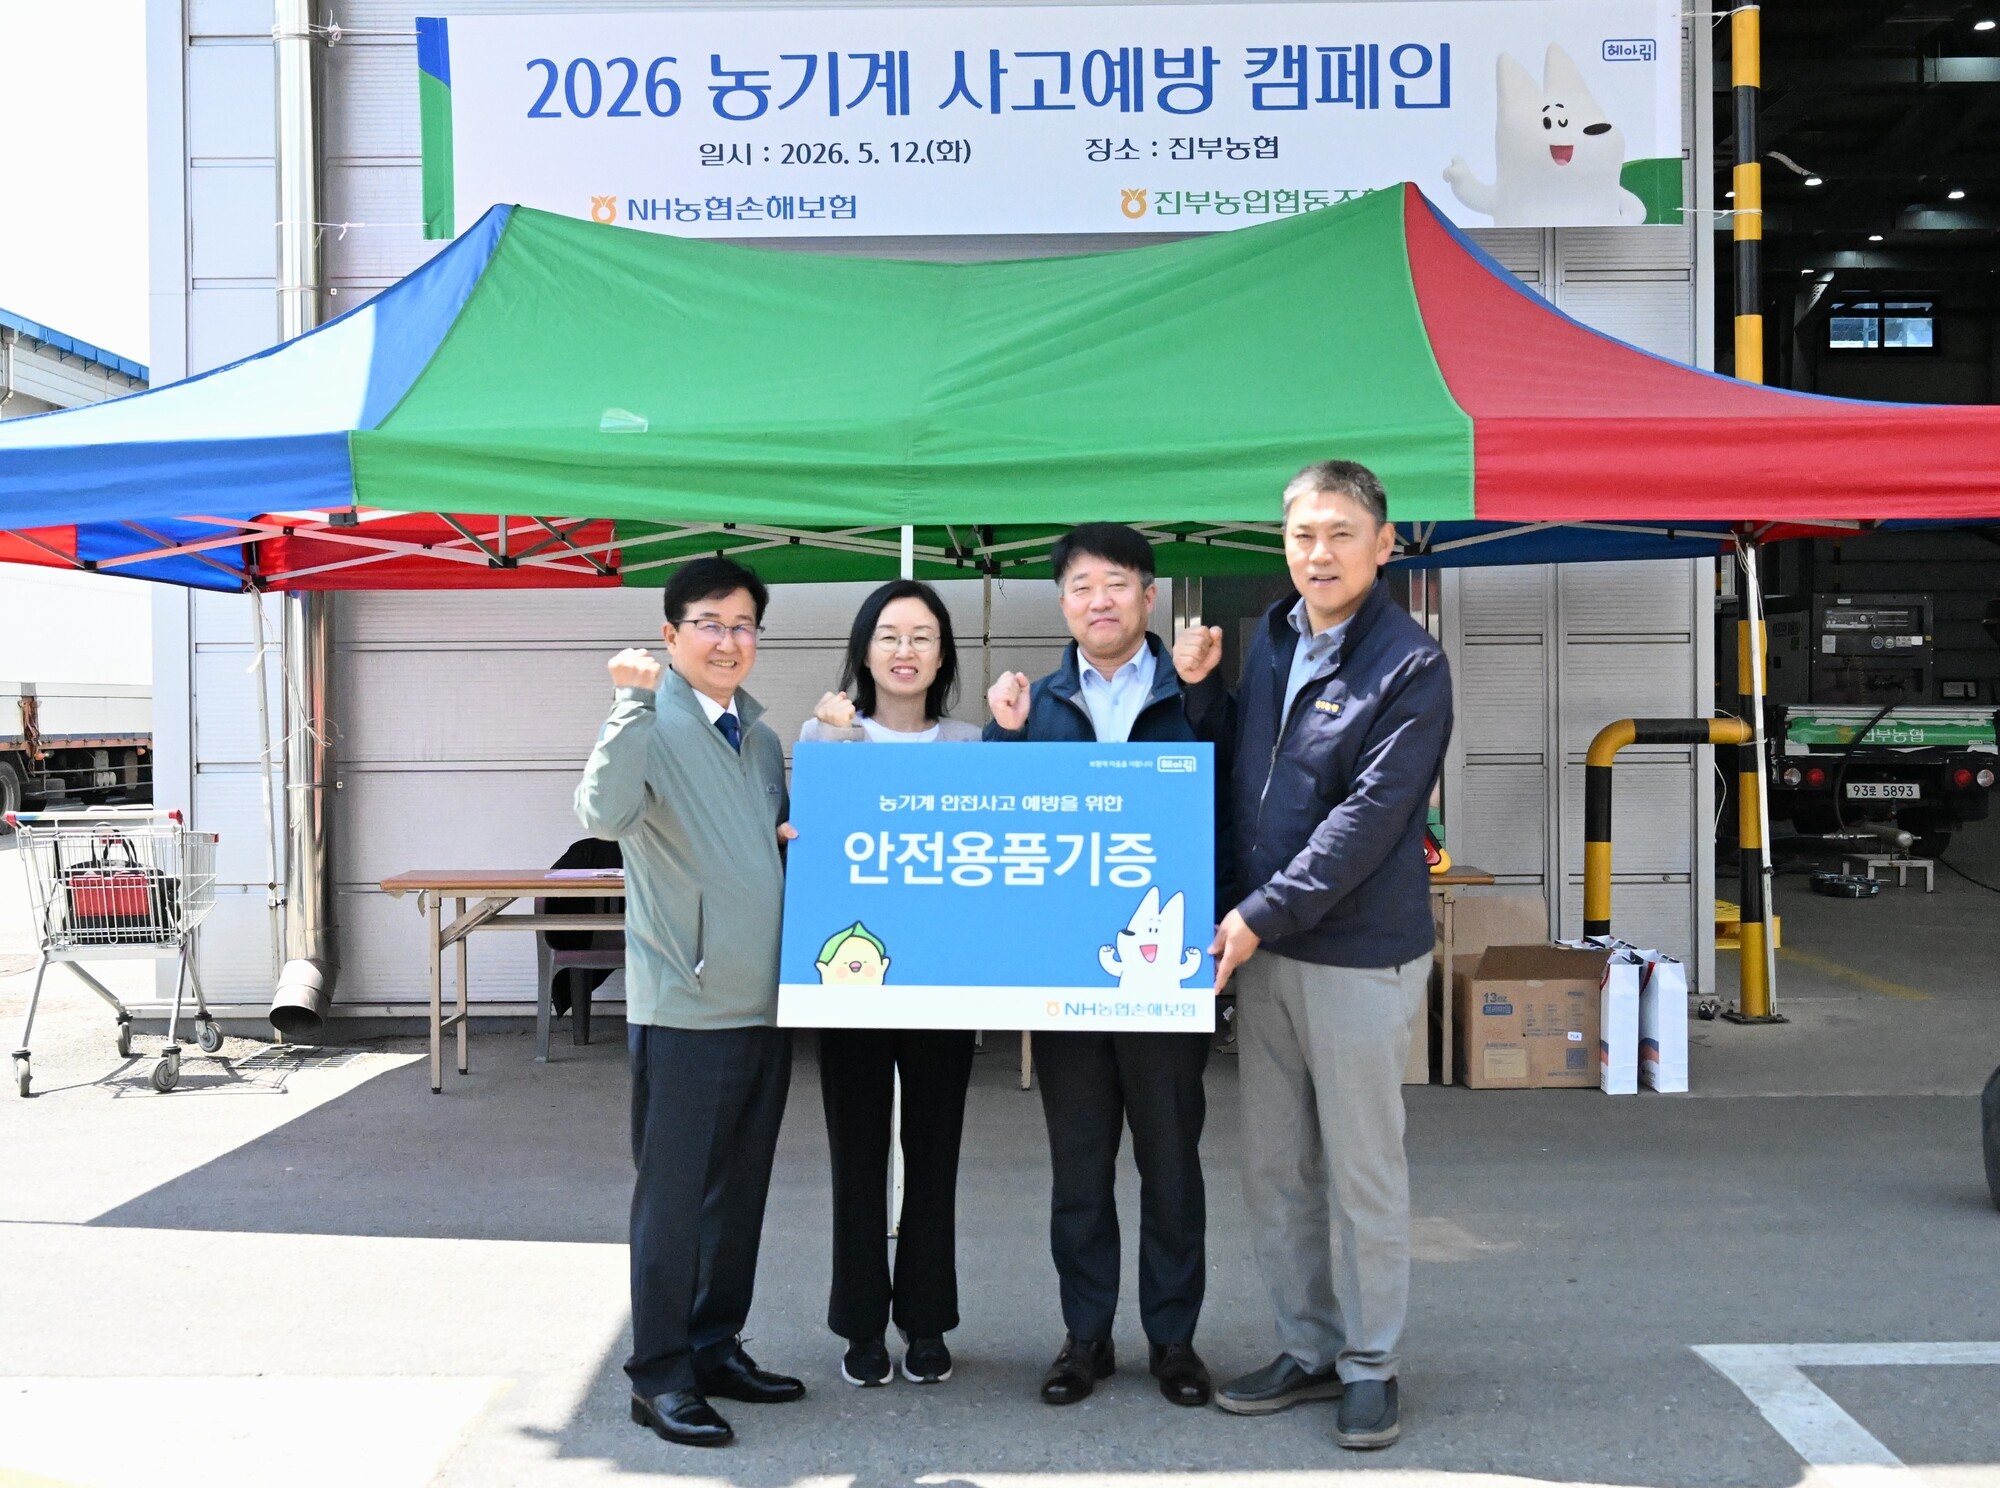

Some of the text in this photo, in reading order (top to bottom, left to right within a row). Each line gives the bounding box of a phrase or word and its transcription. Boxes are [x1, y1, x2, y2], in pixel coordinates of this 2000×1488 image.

[1607, 44, 1651, 61] 헤아림
[526, 42, 1452, 122] 2026 농기계 사고예방 캠페인
[699, 142, 752, 167] 일시
[780, 142, 850, 165] 2026.
[858, 142, 880, 165] 5.
[890, 138, 972, 165] 12.(화)
[1085, 137, 1141, 163] 장소
[1168, 135, 1279, 161] 진부농협
[627, 195, 857, 223] NH농협손해보험
[1154, 188, 1376, 217] 진부농업협동
[1160, 759, 1193, 773] 헤아림
[879, 794, 1124, 812] 농기계 안전사고 예방을 위한
[1852, 784, 1914, 797] 93로 5893
[844, 830, 1158, 888] 안전용품기증
